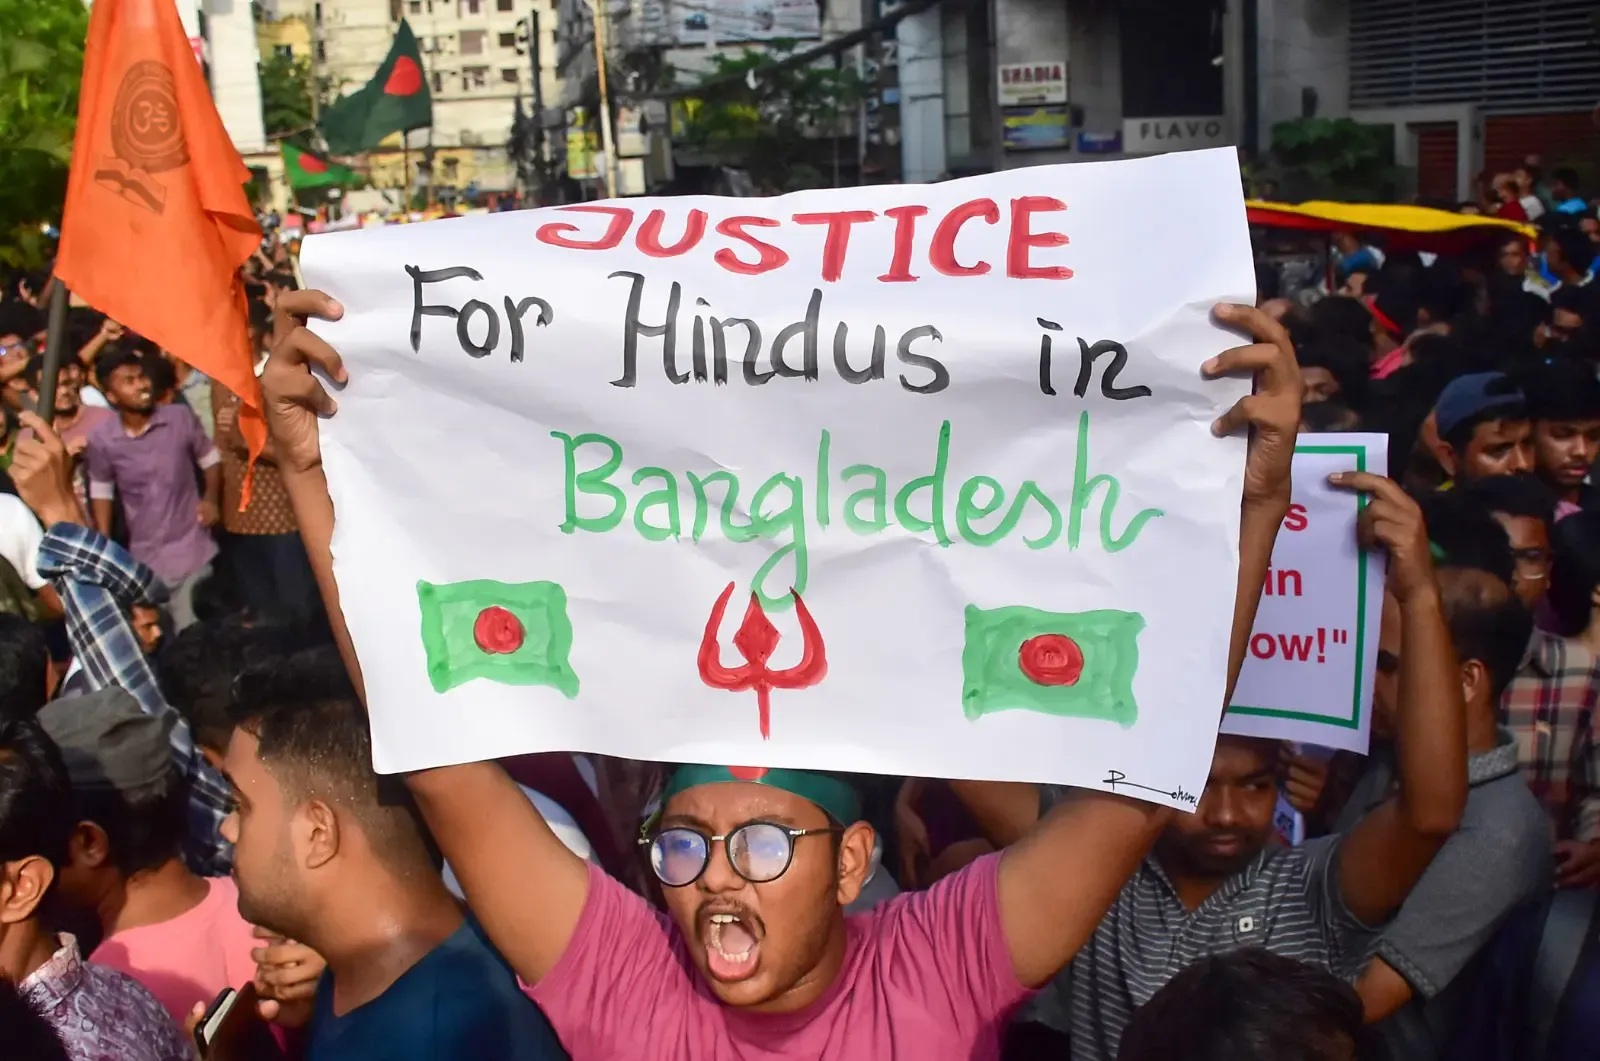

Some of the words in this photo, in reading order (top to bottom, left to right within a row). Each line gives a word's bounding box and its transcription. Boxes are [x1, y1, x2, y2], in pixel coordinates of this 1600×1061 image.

[537, 197, 1074, 282] JUSTICE
[405, 265, 552, 363] For
[608, 271, 951, 395] Hindus
[1037, 318, 1153, 401] in
[551, 411, 1163, 611] Bangladesh
[1243, 628, 1348, 664] ow!"
